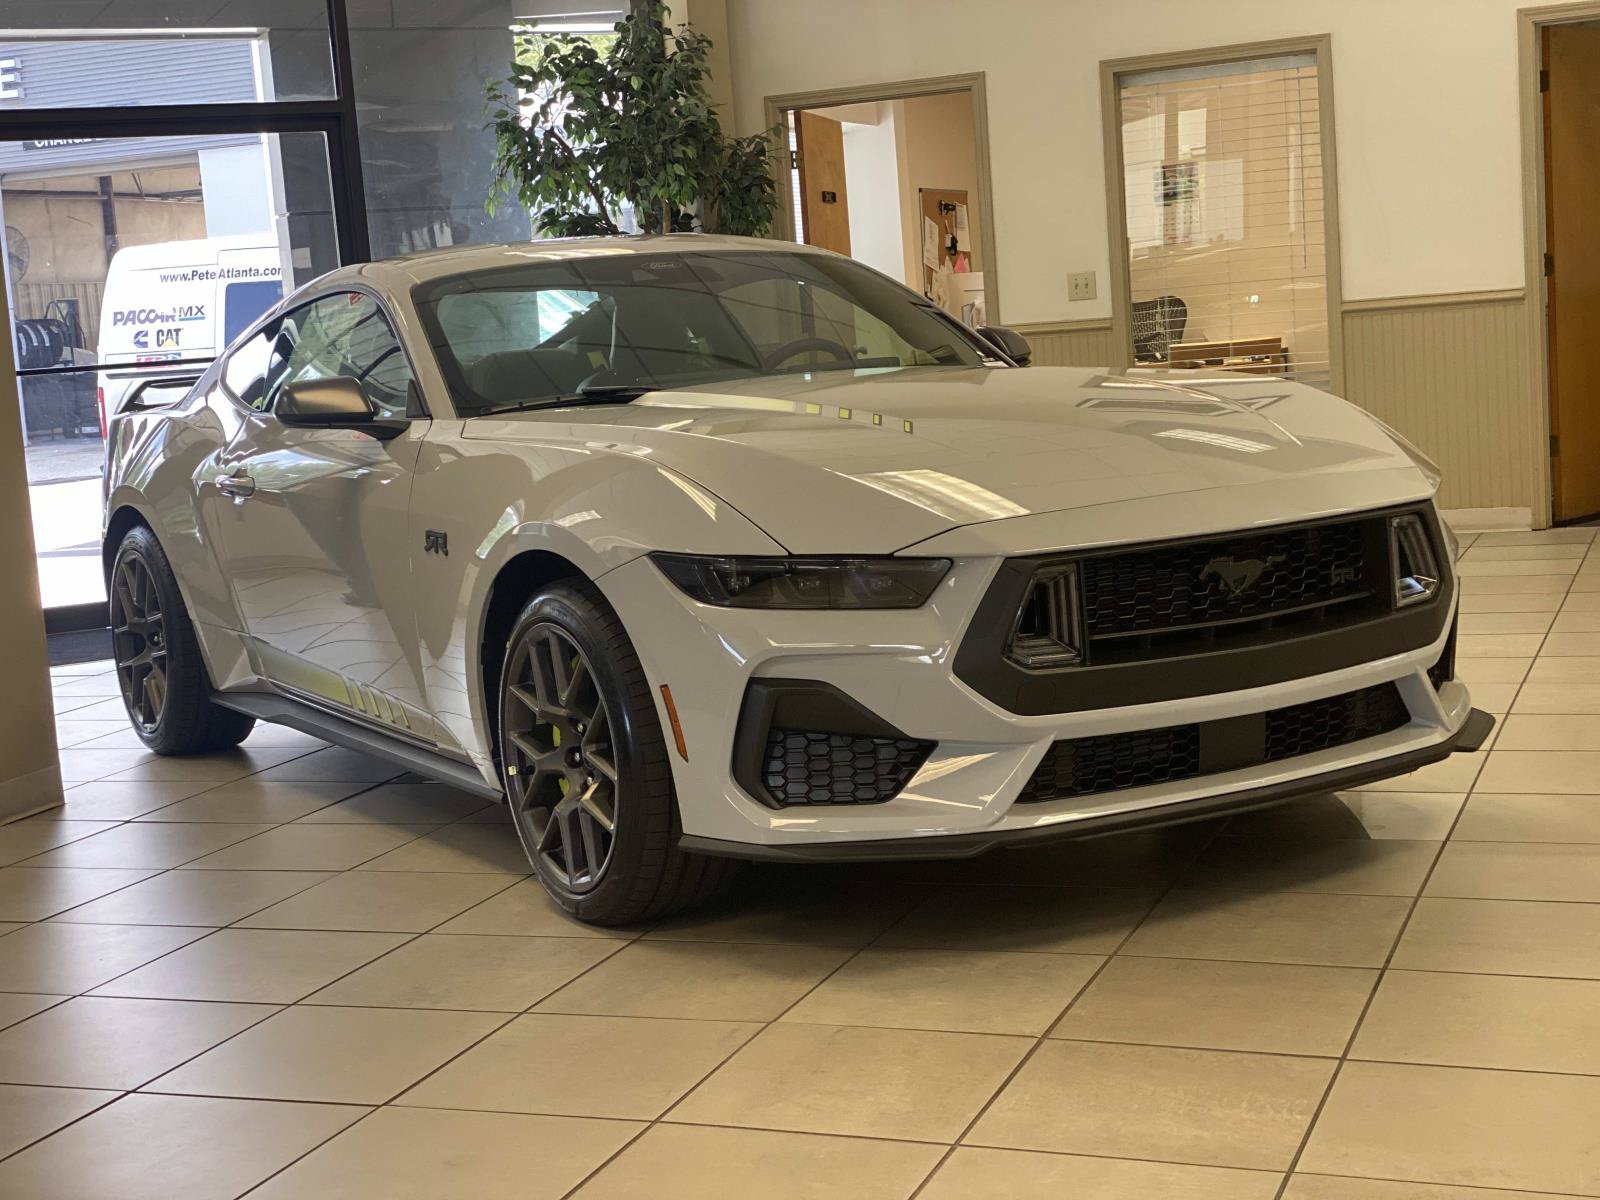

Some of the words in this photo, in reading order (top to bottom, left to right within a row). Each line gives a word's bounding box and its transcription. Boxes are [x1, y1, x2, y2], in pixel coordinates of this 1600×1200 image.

[0, 58, 25, 98] E
[34, 138, 92, 148] CHAN
[178, 305, 205, 317] MX
[156, 328, 182, 348] CAT
